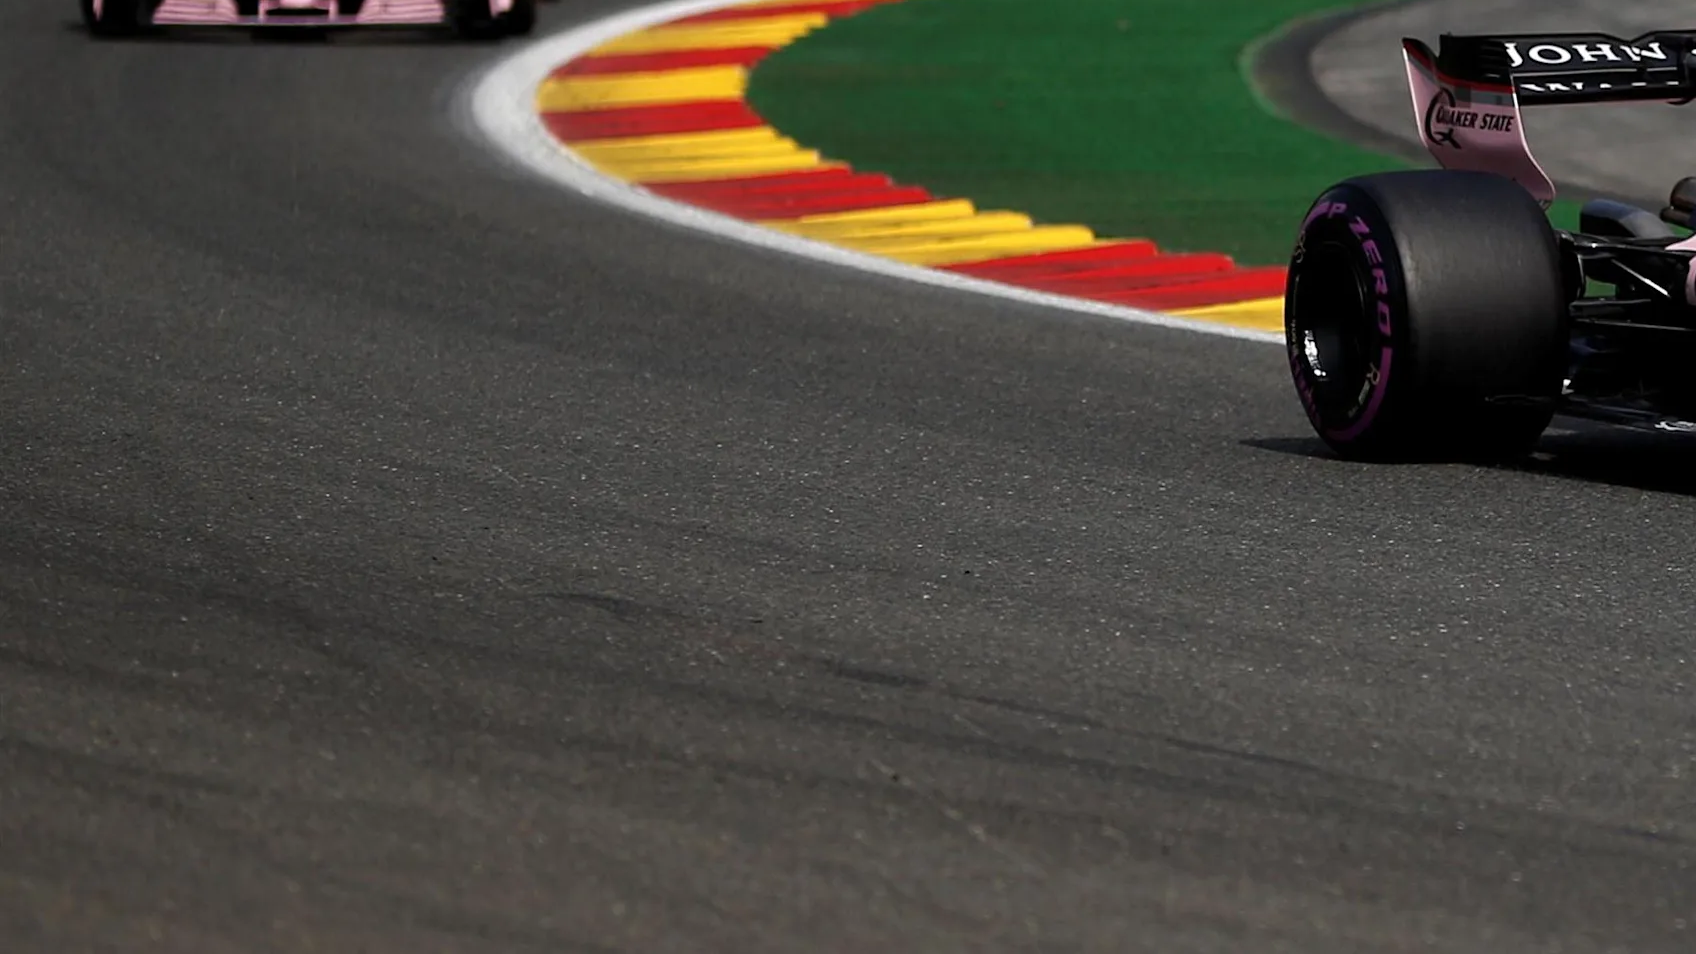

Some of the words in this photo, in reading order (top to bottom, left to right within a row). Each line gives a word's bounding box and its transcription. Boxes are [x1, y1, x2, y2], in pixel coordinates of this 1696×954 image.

[1479, 113, 1514, 132] STATE
[1328, 202, 1348, 218] P
[1350, 216, 1392, 336] ZERO
